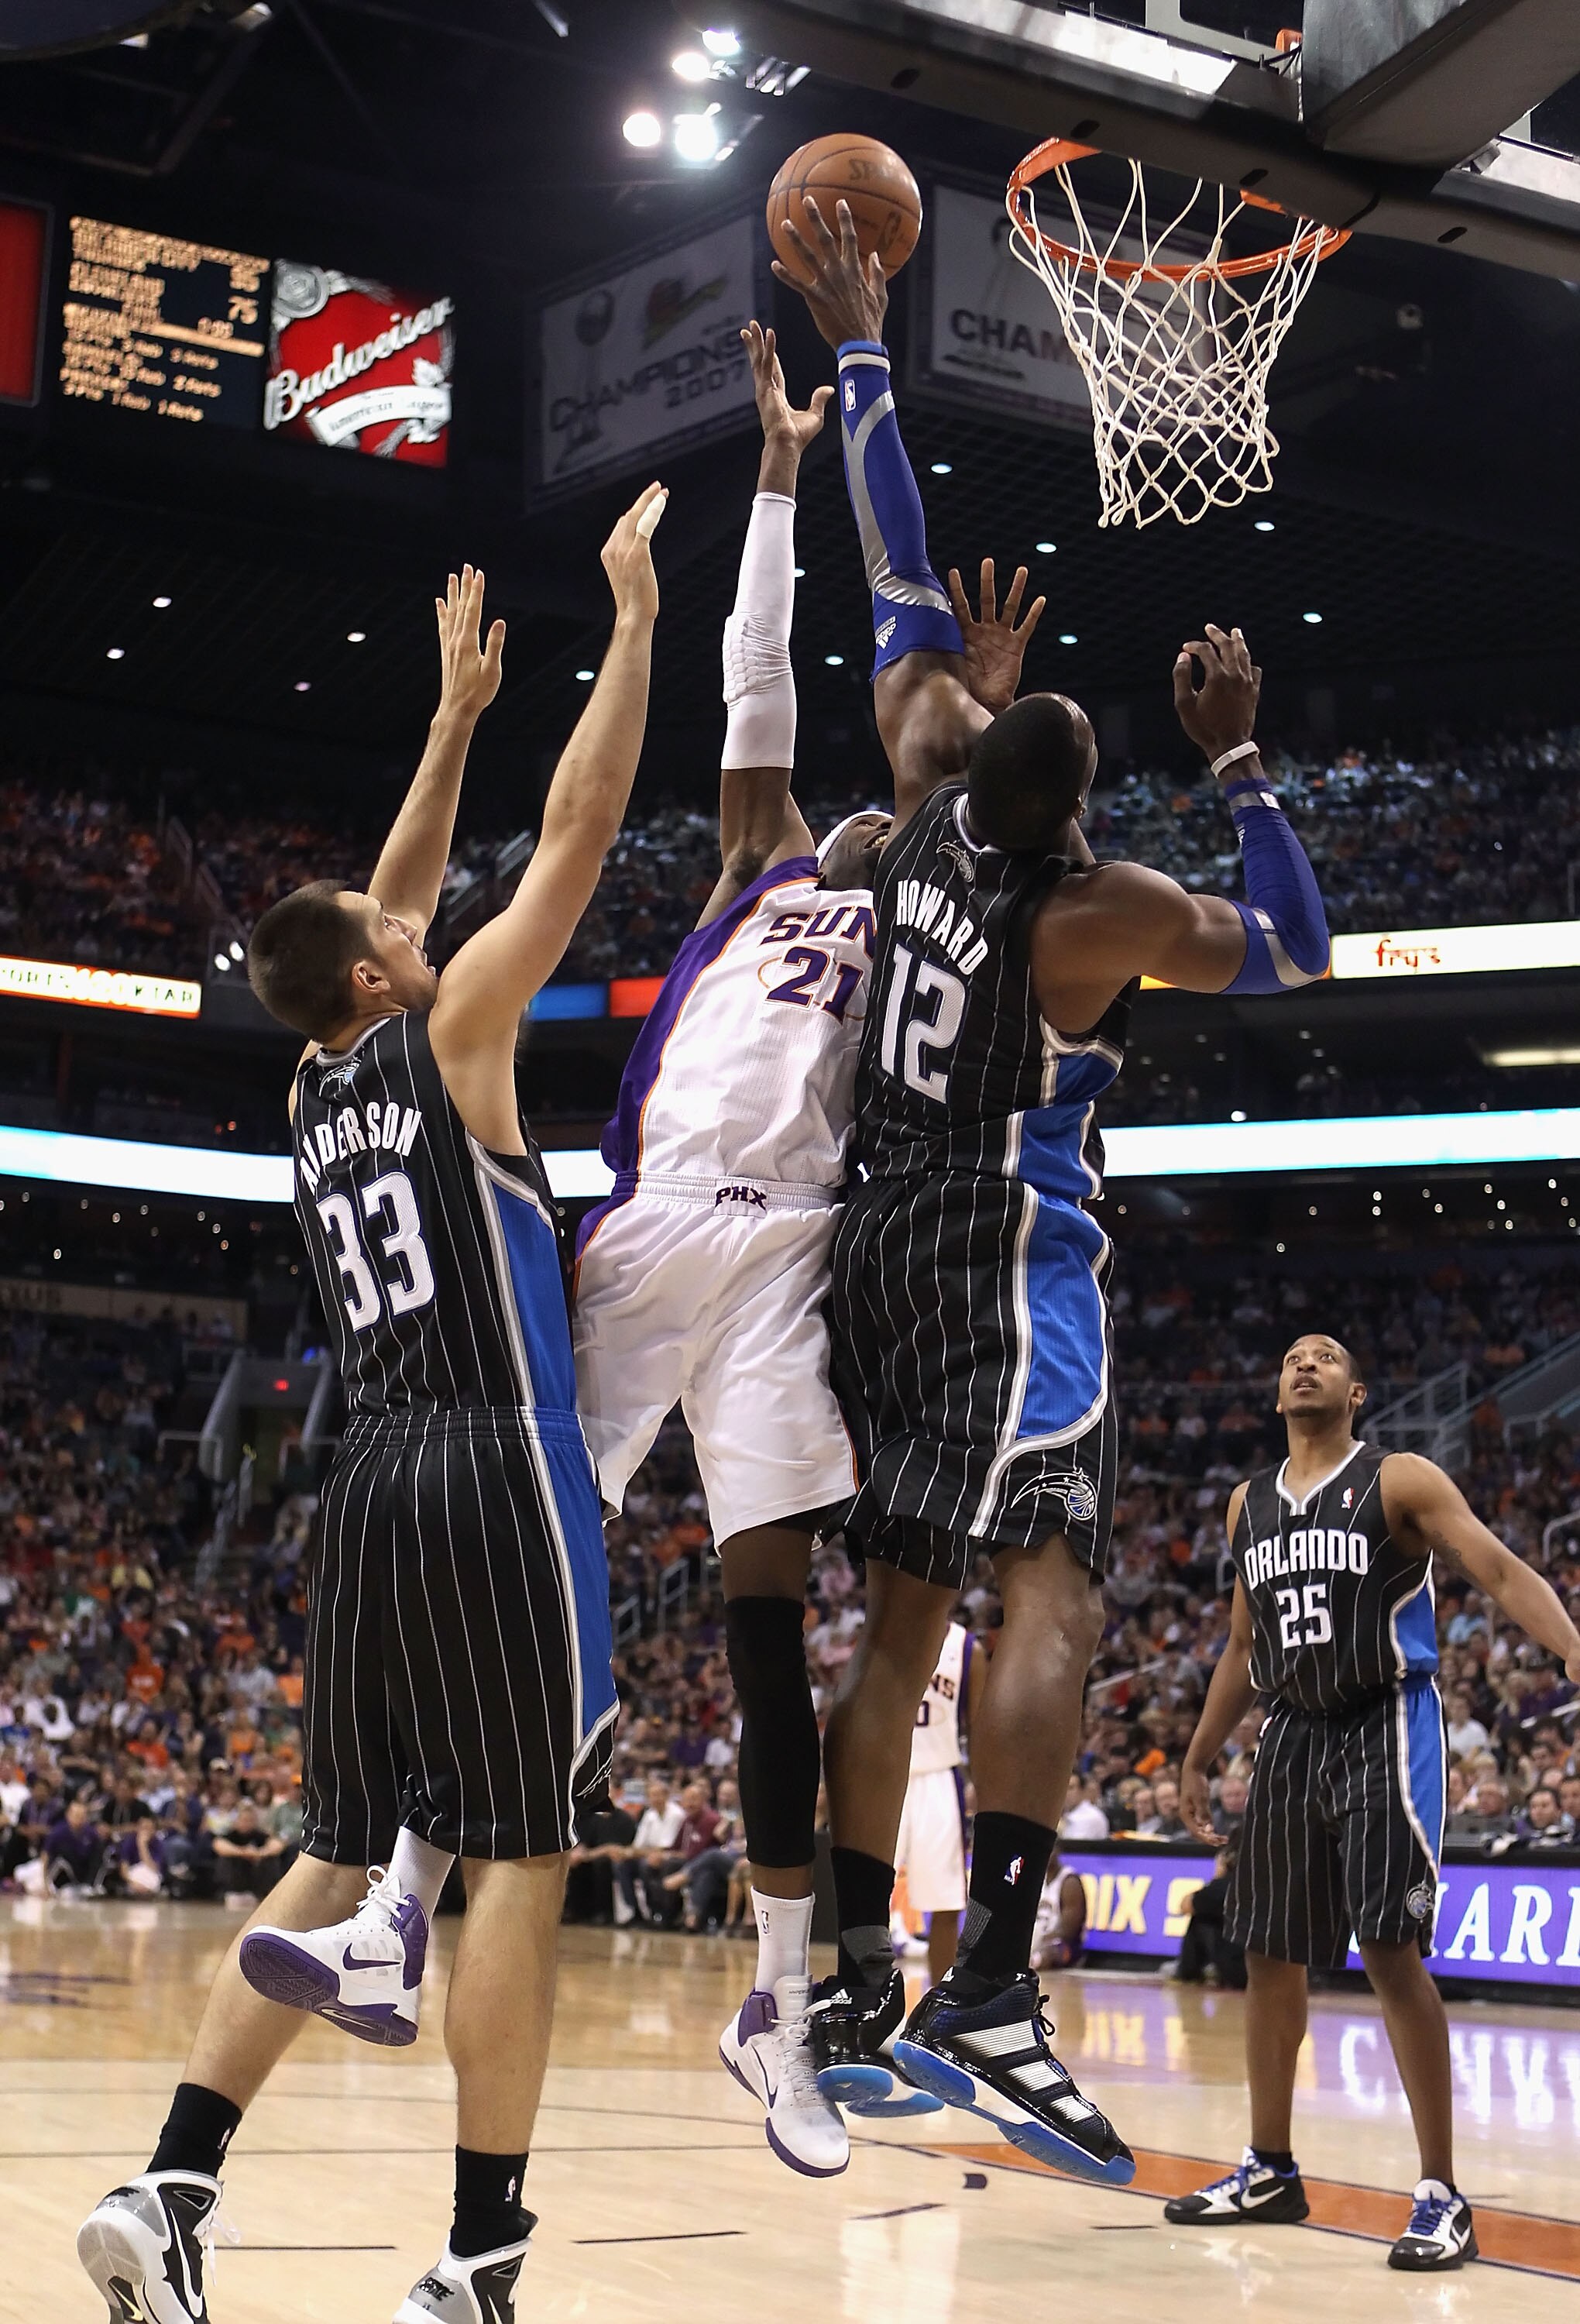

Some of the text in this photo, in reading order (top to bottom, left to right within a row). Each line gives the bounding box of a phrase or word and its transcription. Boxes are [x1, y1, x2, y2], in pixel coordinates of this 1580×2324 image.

[263, 297, 454, 431] Budweiser
[943, 308, 1073, 366] CHAM
[665, 358, 746, 409] 2007
[756, 905, 877, 962] SUN
[896, 878, 989, 975] HOWARD
[764, 946, 864, 1027] 21
[881, 942, 966, 1104] 12
[300, 1101, 422, 1196] ANDERSON
[715, 1185, 767, 1211] PHX
[315, 1171, 435, 1333] 33
[1244, 1528, 1369, 1591] ORLANDO
[1275, 1583, 1333, 1650] 25
